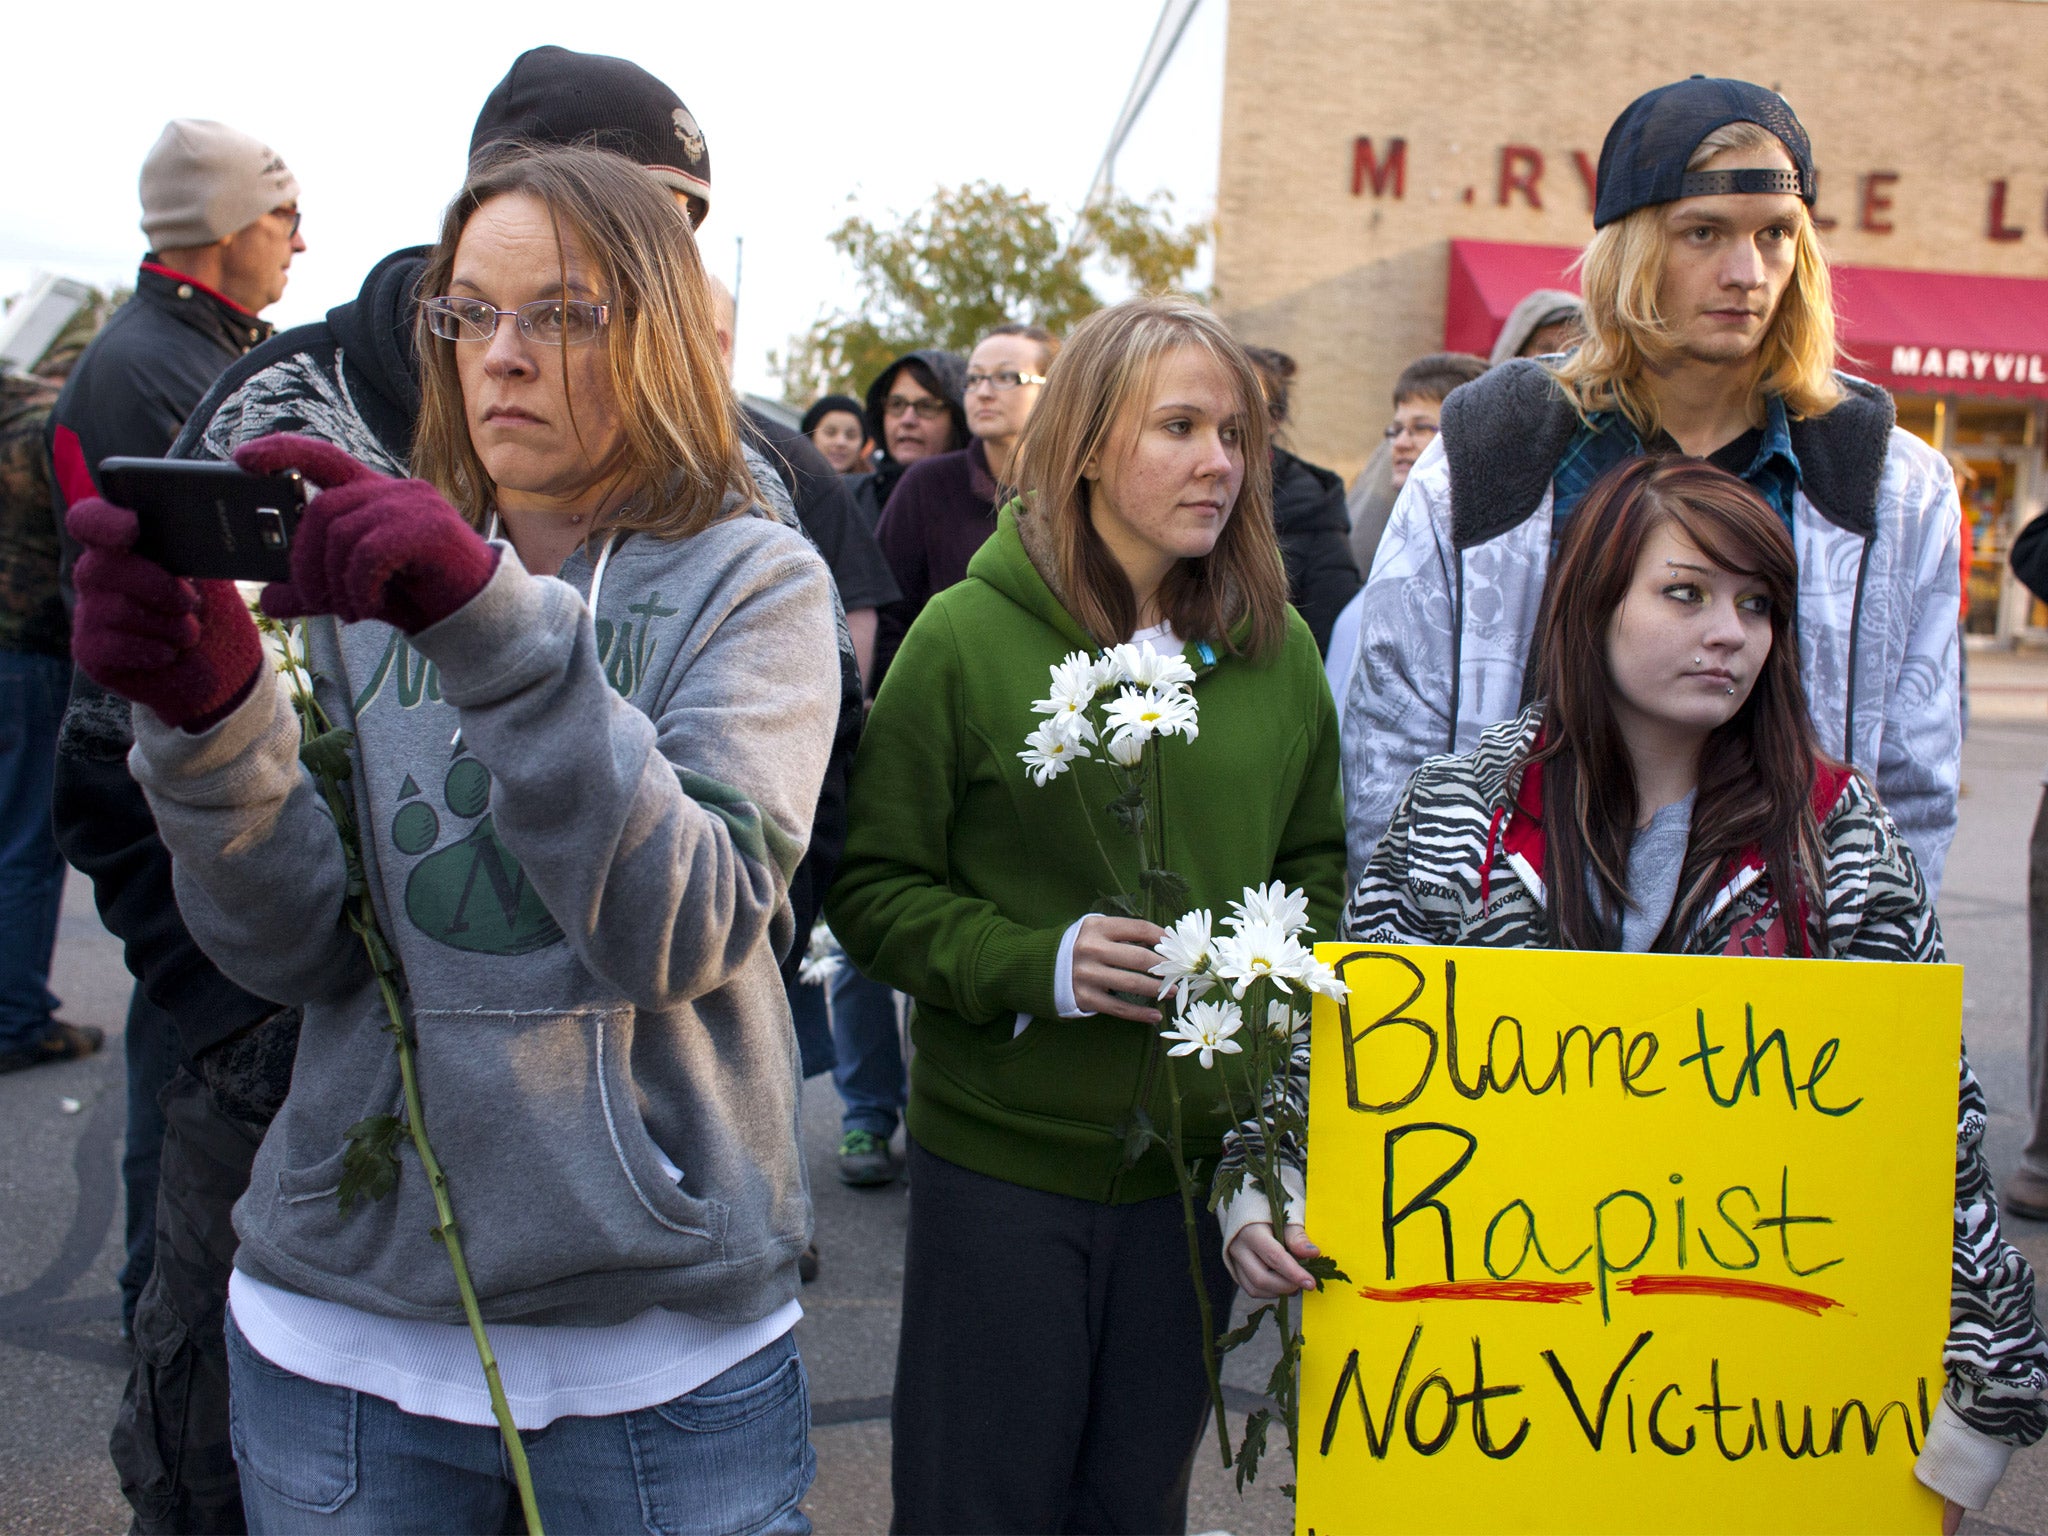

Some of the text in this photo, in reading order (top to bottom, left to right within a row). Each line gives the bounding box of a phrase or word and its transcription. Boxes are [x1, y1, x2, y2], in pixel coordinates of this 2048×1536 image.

[1334, 951, 1864, 1117] Blame the
[1383, 1122, 1845, 1326] Rapist
[1319, 1324, 1531, 1460] Not
